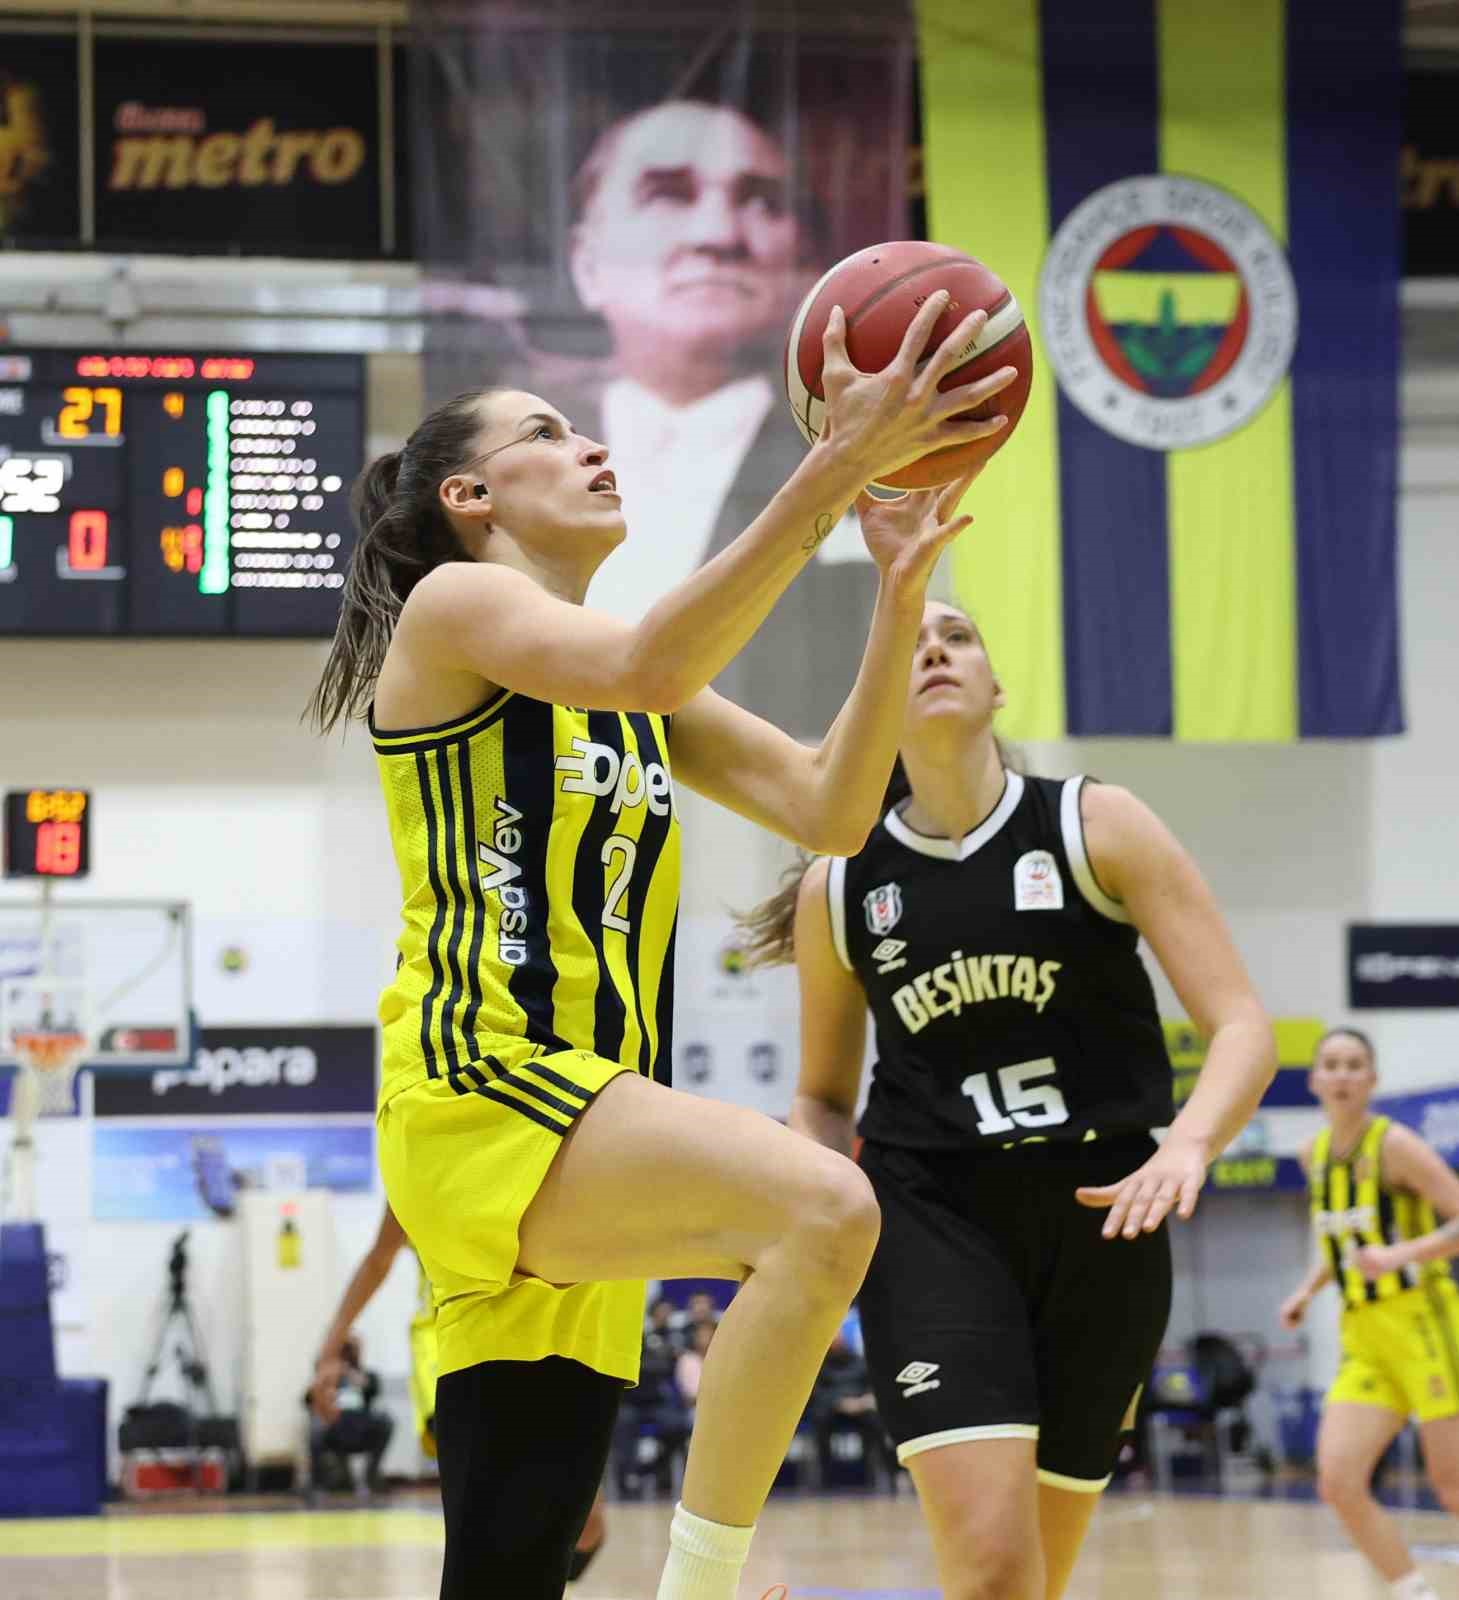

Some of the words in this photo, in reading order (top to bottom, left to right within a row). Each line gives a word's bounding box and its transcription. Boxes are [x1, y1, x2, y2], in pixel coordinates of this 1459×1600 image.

[110, 118, 364, 190] metro
[58, 387, 123, 439] 27
[68, 509, 108, 571] 0
[479, 795, 528, 966] arsaVev
[600, 834, 639, 935] 2
[891, 950, 1063, 1034] BEŞİKTAŞ
[960, 1056, 1070, 1135] 15
